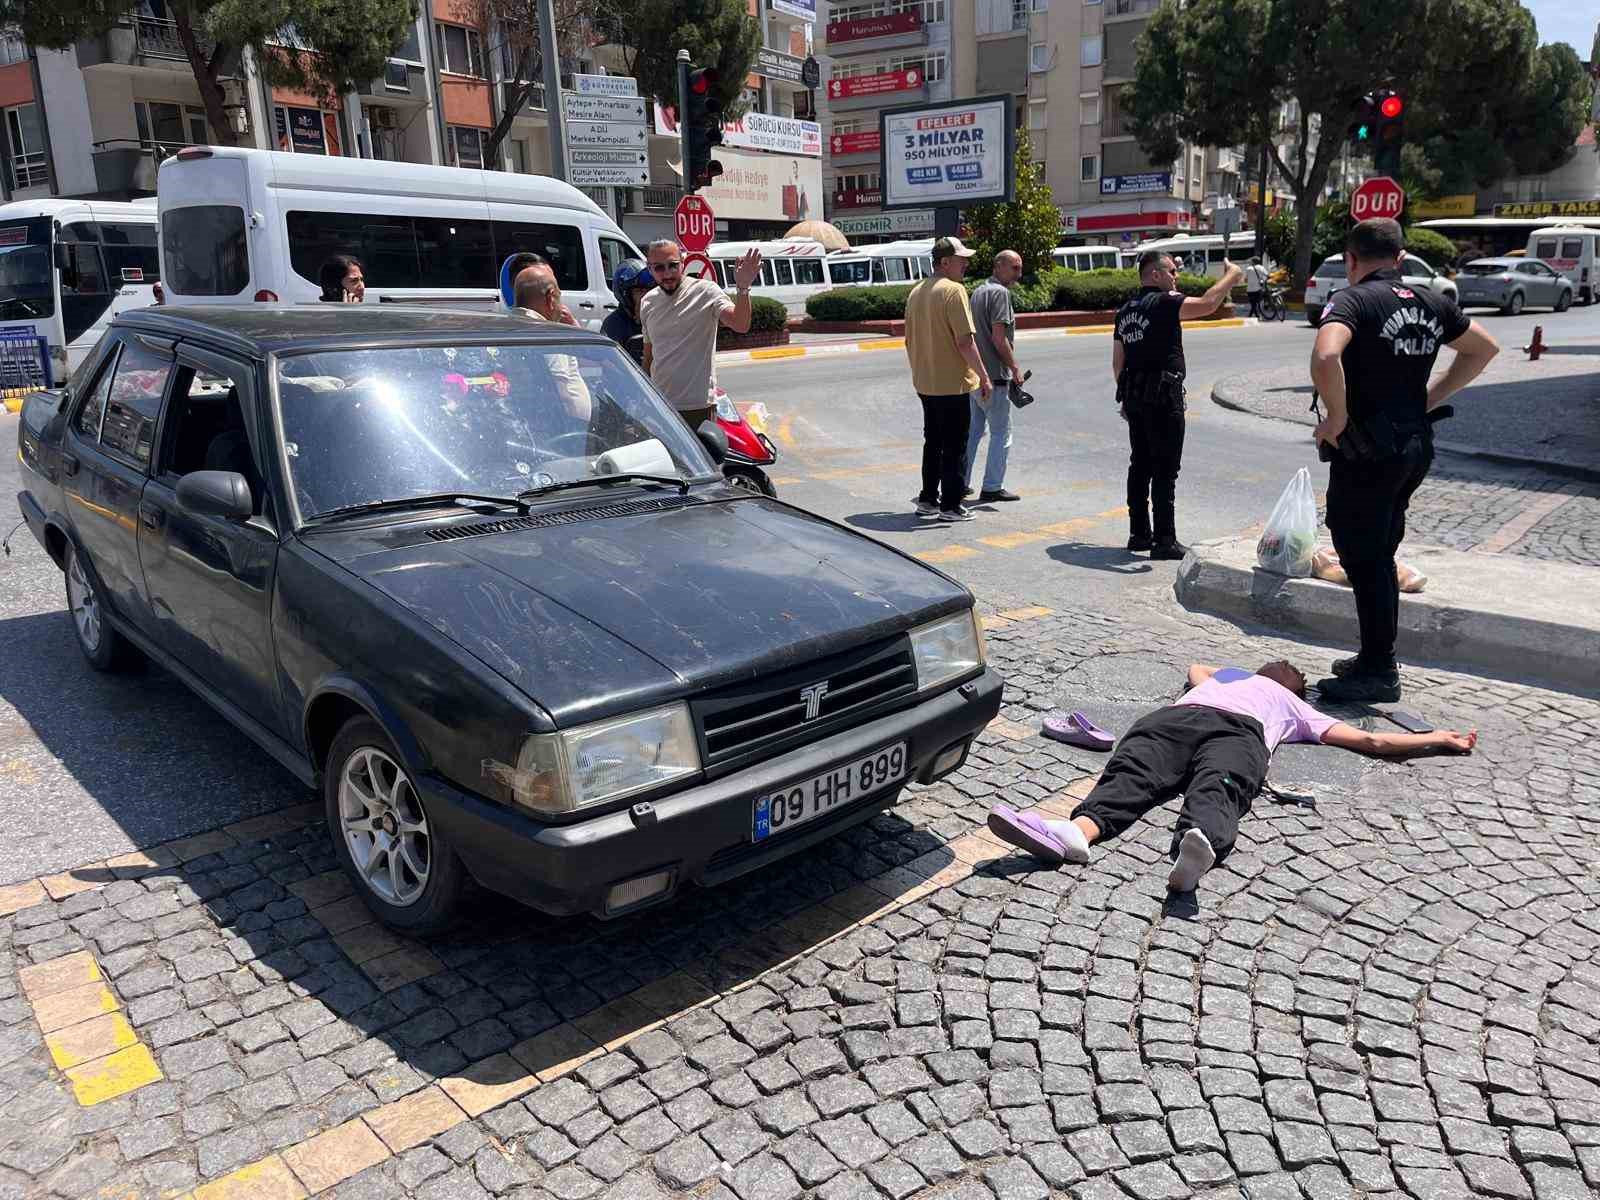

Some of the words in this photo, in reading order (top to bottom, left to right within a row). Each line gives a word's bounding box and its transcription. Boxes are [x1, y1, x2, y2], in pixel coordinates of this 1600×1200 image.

[748, 115, 776, 134] SÜRÜCÜ
[778, 121, 800, 137] KURSU
[570, 135, 596, 143] Merkez
[905, 135, 915, 148] 3
[919, 128, 984, 147] MİLYAR
[905, 151, 926, 161] 950
[928, 145, 970, 158] MİLYON
[974, 144, 986, 153] TL
[926, 168, 938, 177] KM
[1356, 192, 1399, 213] DUR
[1502, 203, 1553, 215] ZAFER
[678, 213, 711, 236] DUR
[1380, 307, 1444, 341] YUNUSLAR
[1122, 328, 1144, 344] POLİS
[1395, 334, 1436, 356] POLİS
[770, 787, 804, 828] 09
[814, 768, 850, 811] HH
[860, 746, 903, 791] 899
[757, 819, 768, 830] TR
